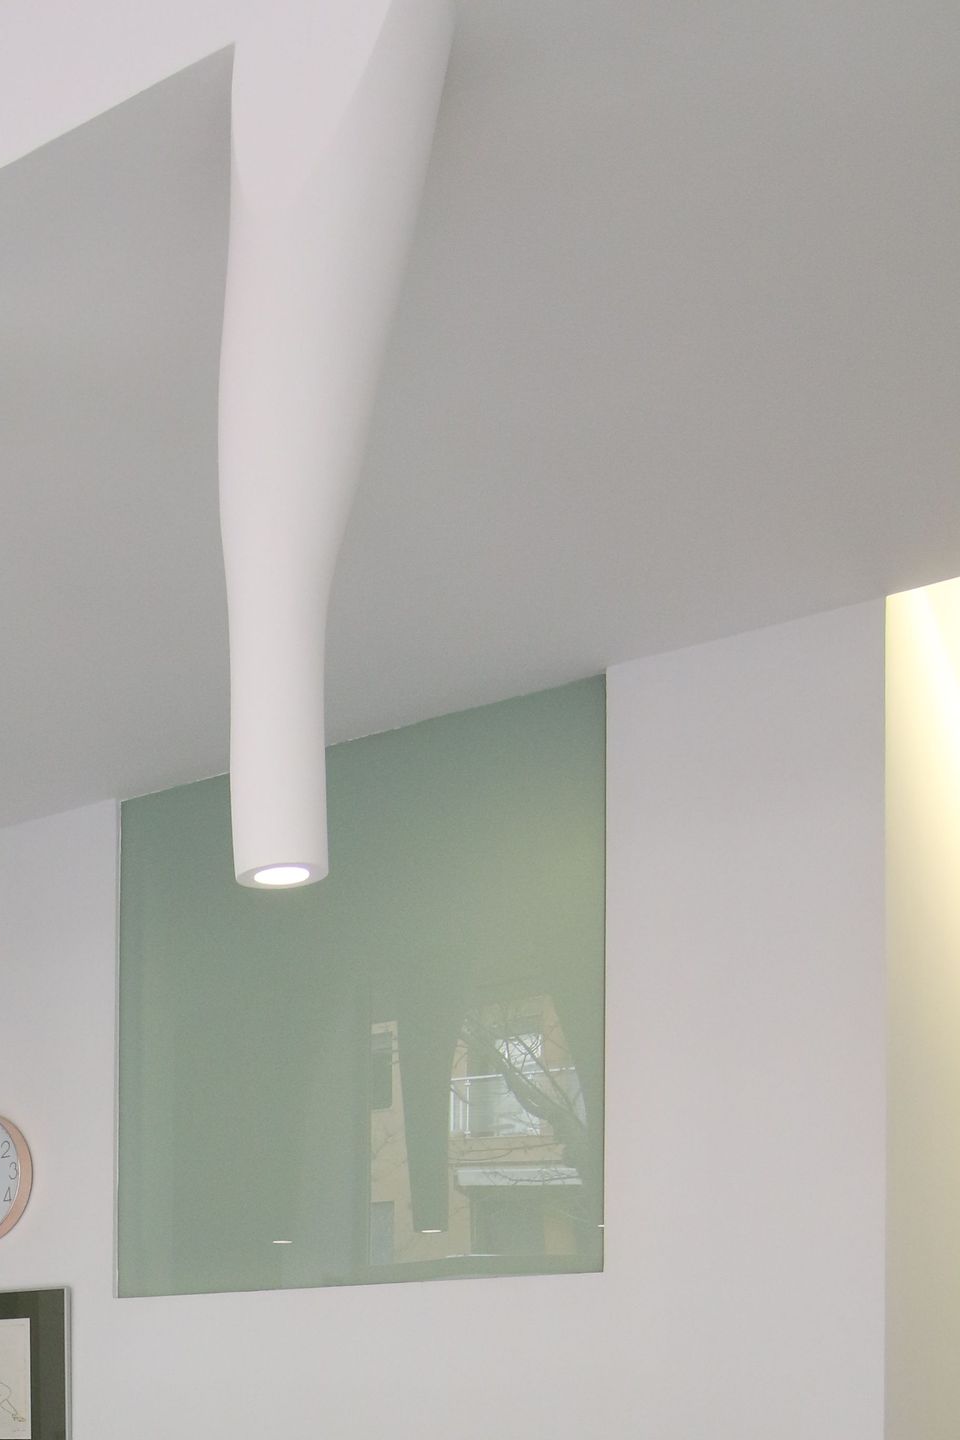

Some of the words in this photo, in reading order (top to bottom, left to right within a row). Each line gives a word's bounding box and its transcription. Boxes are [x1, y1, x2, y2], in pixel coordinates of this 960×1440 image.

[0, 1140, 11, 1159] 2
[8, 1161, 18, 1180] 3
[3, 1186, 12, 1202] 4
